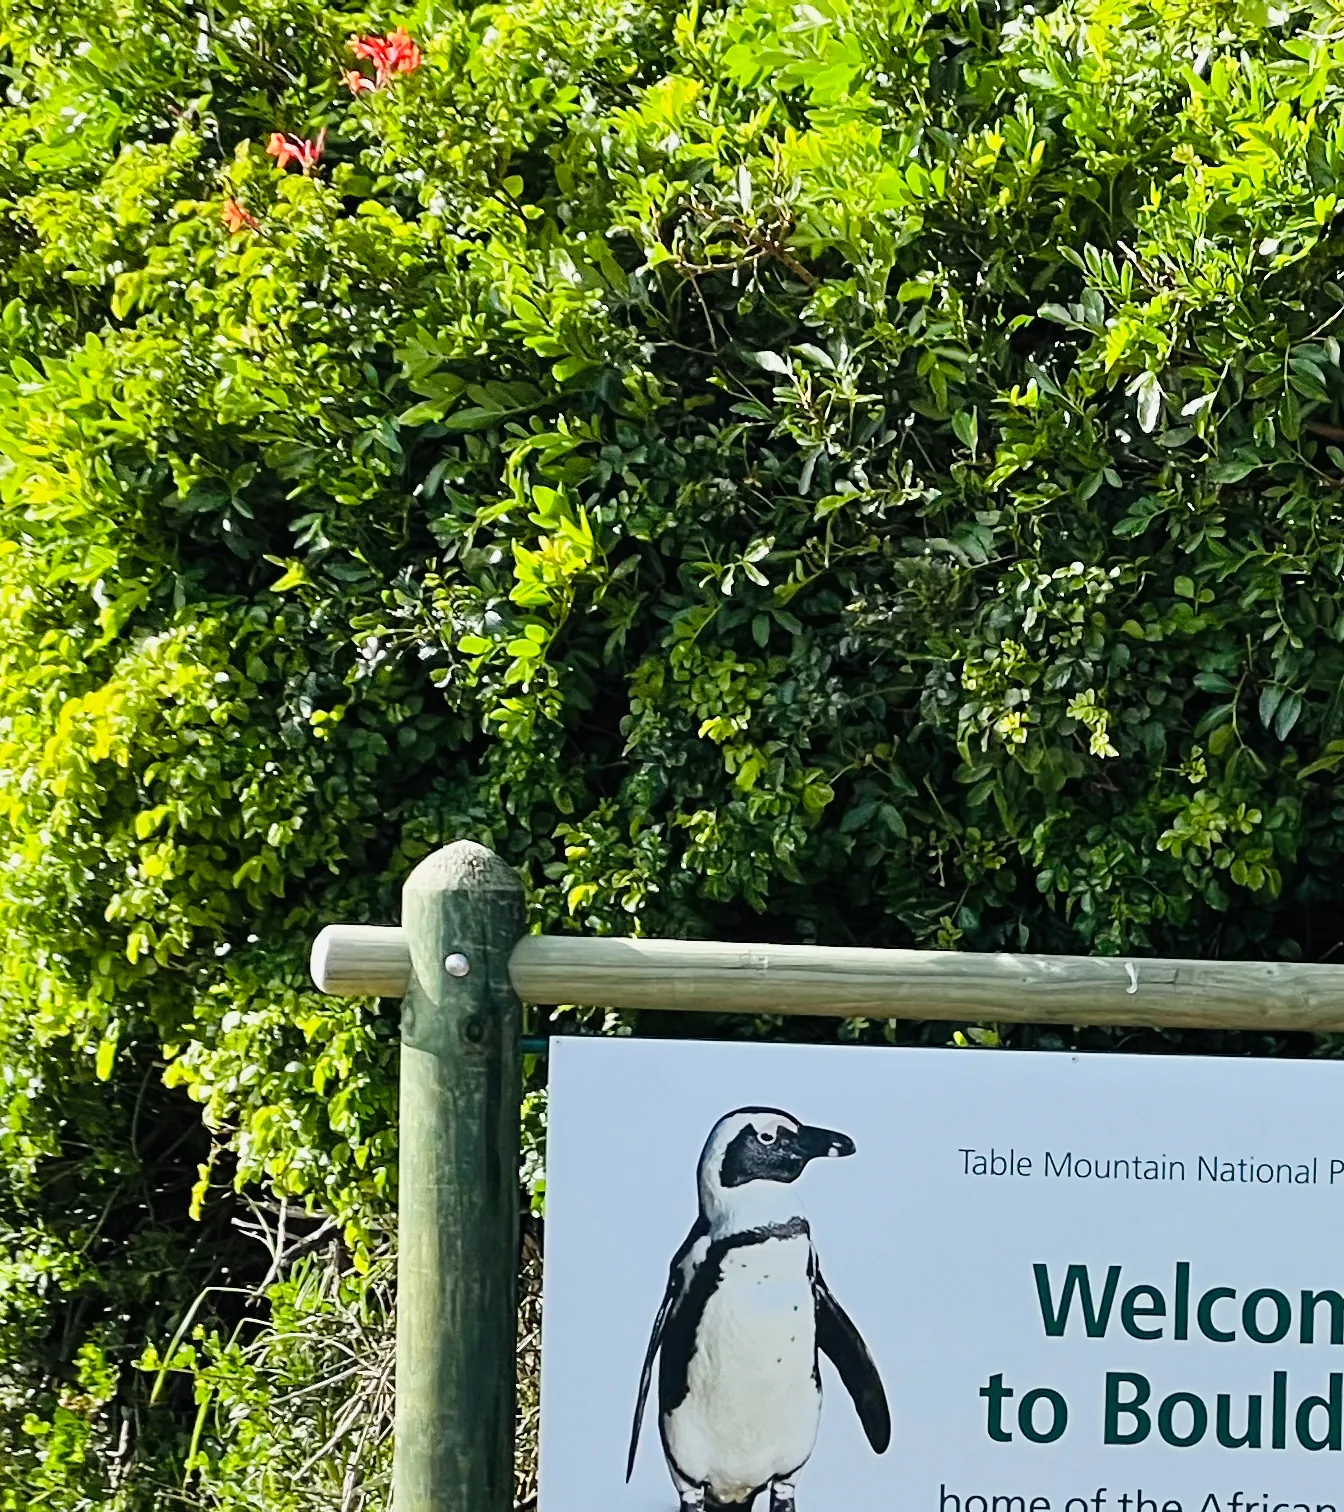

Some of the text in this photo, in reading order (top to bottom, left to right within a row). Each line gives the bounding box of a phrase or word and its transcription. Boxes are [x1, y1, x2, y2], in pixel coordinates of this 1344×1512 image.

[957, 1147, 1033, 1177] Table
[1044, 1151, 1185, 1181] Mountain
[1197, 1155, 1317, 1185] National
[978, 1372, 1068, 1444] to
